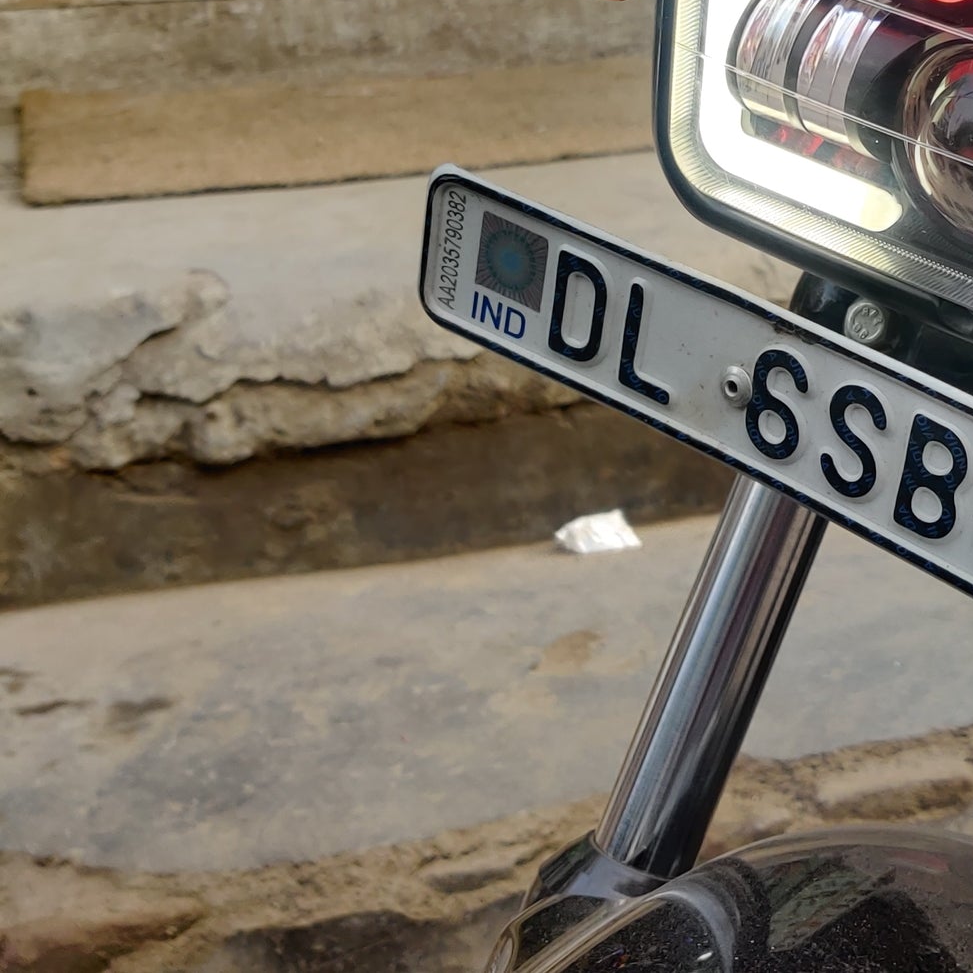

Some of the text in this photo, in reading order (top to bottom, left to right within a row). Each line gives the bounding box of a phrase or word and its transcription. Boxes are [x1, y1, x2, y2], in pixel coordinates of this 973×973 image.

[438, 190, 466, 310] AA2035790382
[471, 291, 526, 339] IND
[548, 249, 670, 406] DL
